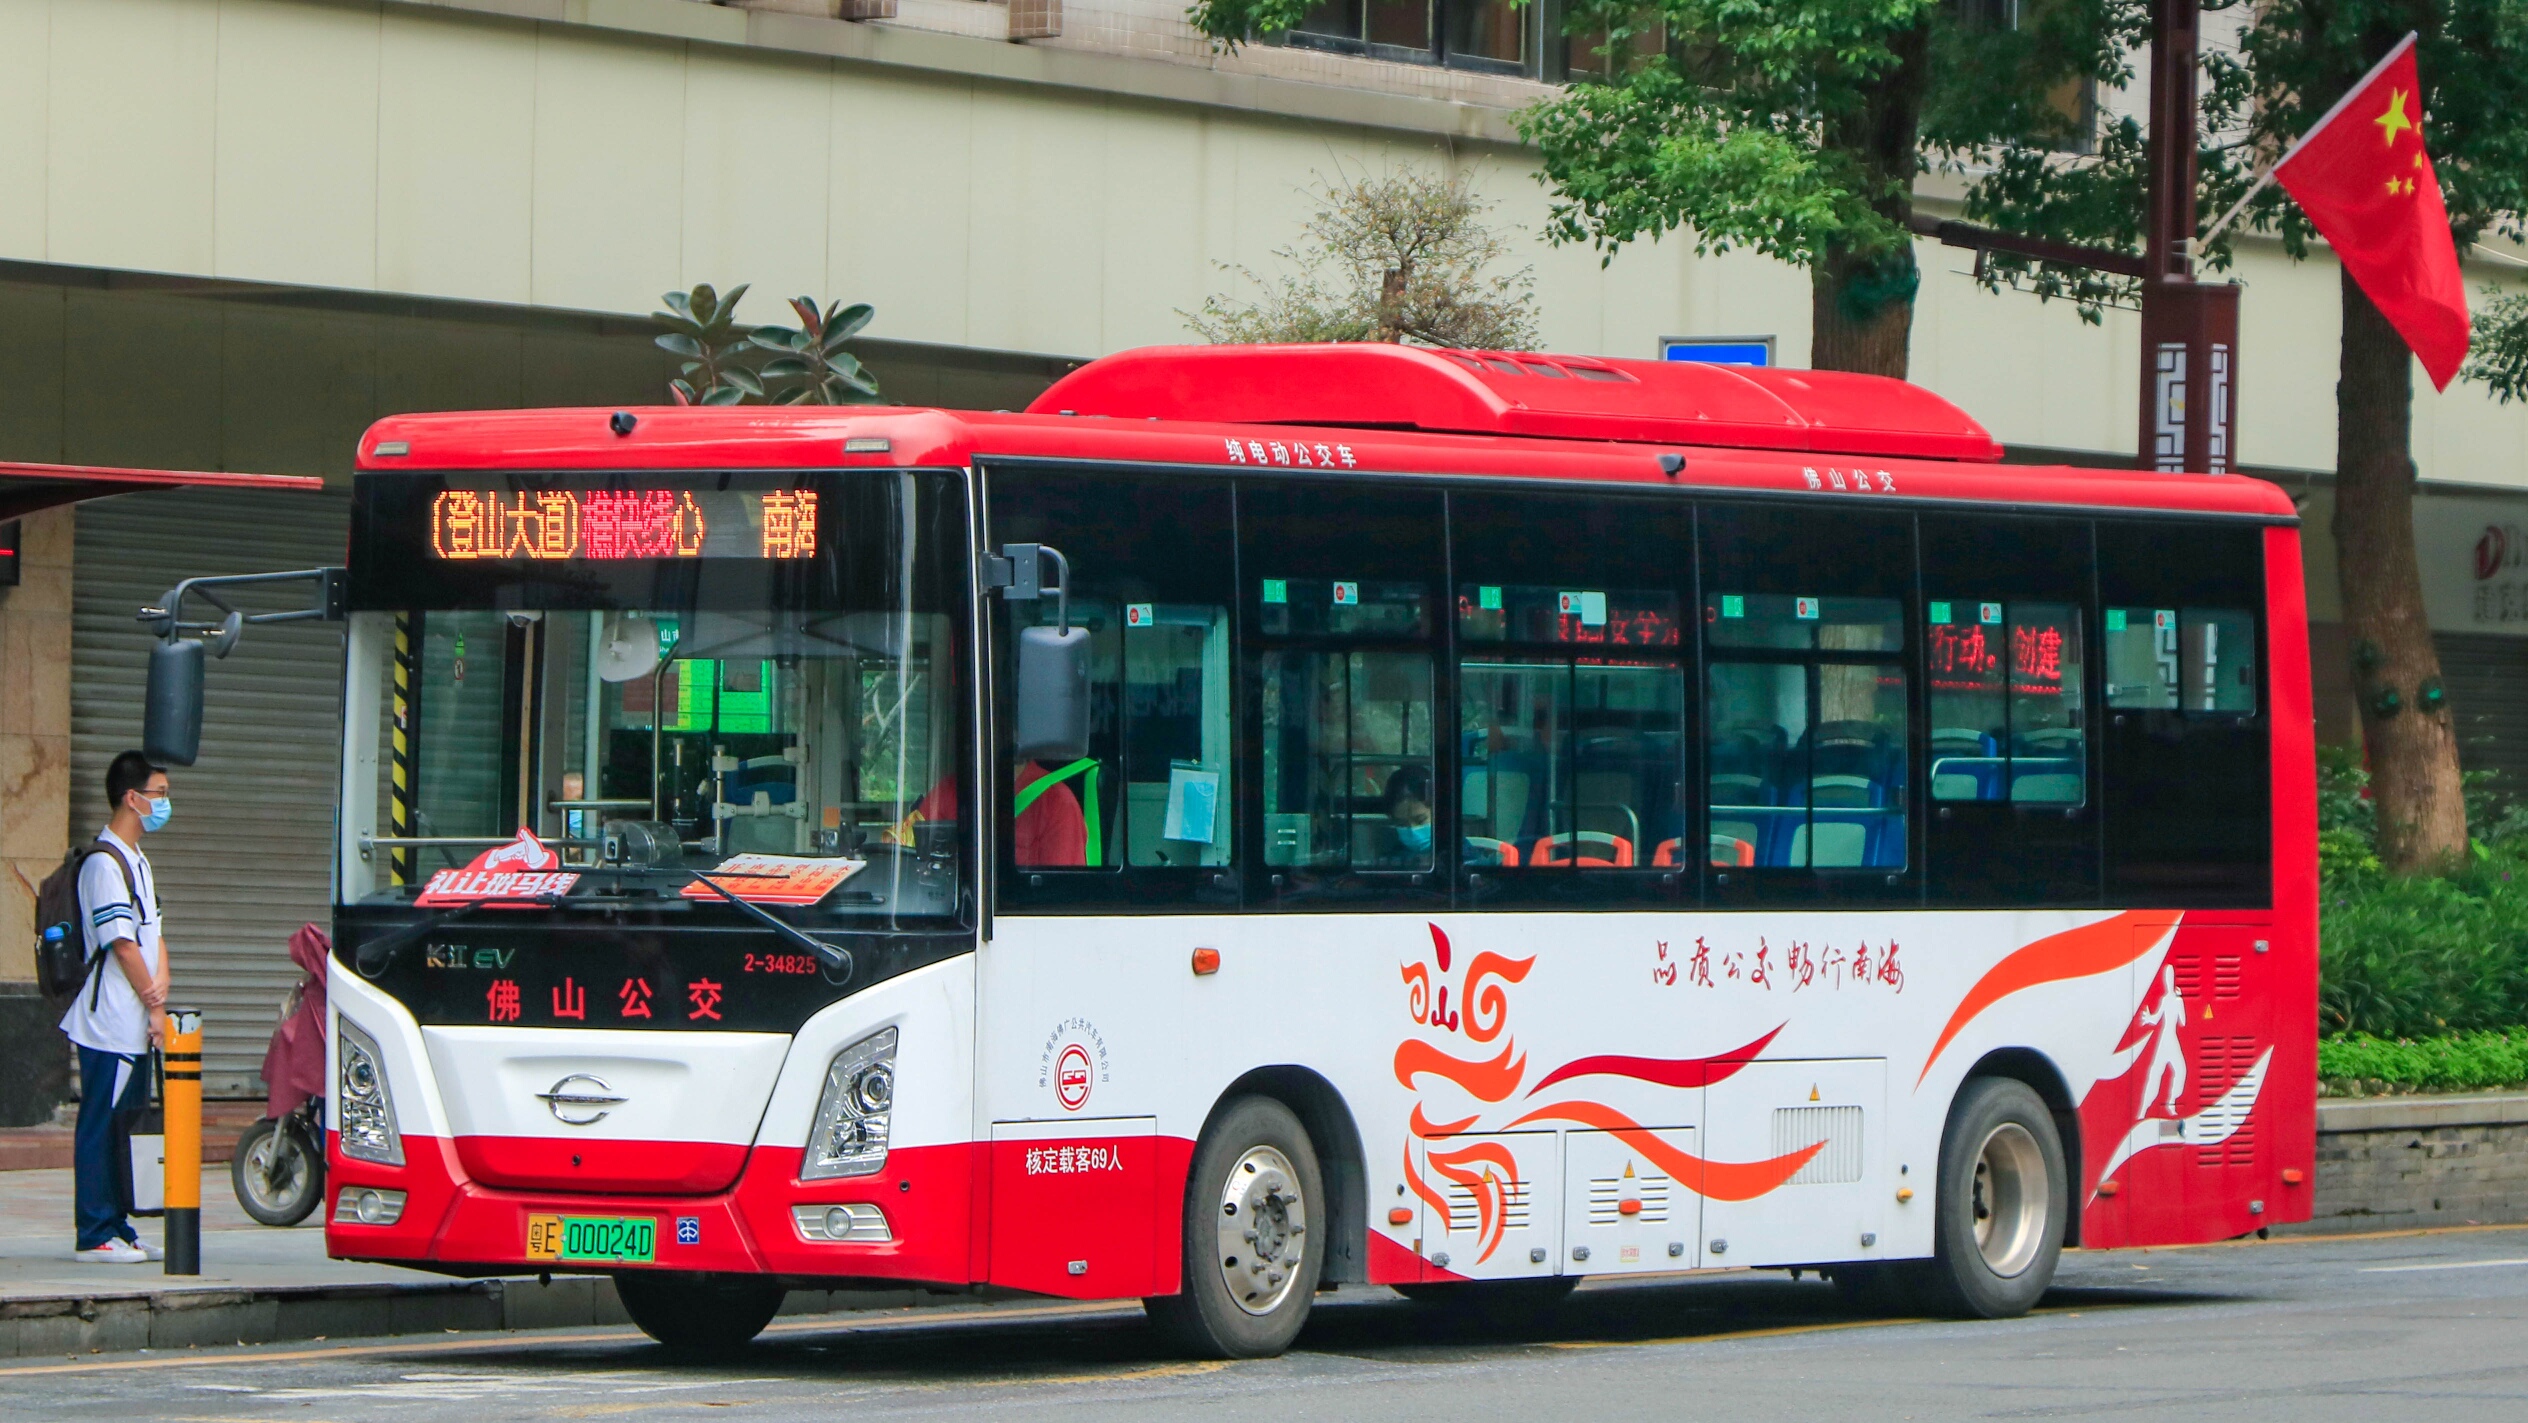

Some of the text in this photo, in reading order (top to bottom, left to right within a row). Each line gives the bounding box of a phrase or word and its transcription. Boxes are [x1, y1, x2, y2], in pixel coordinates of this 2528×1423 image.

[1224, 438, 1358, 469] 纯电动公交车
[1802, 466, 1897, 492] 佛山公交
[424, 870, 578, 896] 礼让斑马线
[743, 953, 817, 975] 2-34825
[486, 977, 723, 1022] 佛山公交
[1025, 1144, 1124, 1176] 核定载客69人
